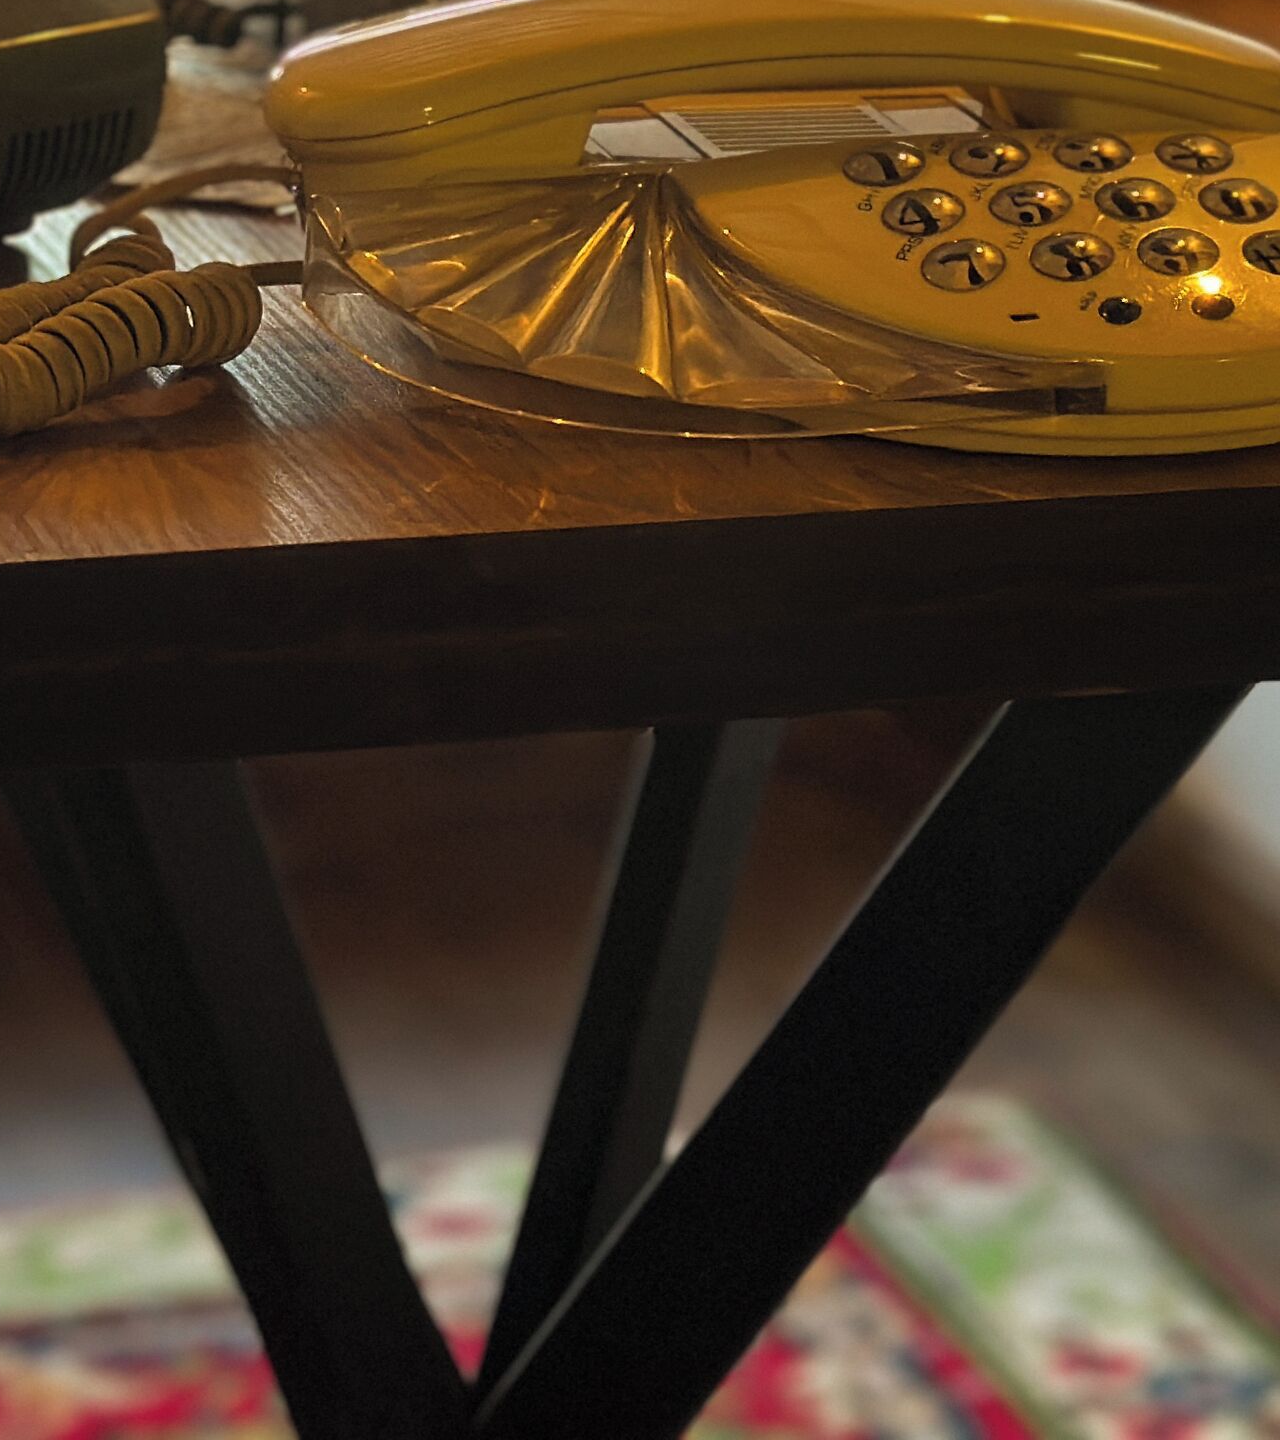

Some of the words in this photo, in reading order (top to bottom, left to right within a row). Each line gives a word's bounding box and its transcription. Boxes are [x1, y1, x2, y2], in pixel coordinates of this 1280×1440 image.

[898, 198, 942, 236] 4
[1008, 191, 1054, 224] 5
[937, 251, 986, 286] 7
